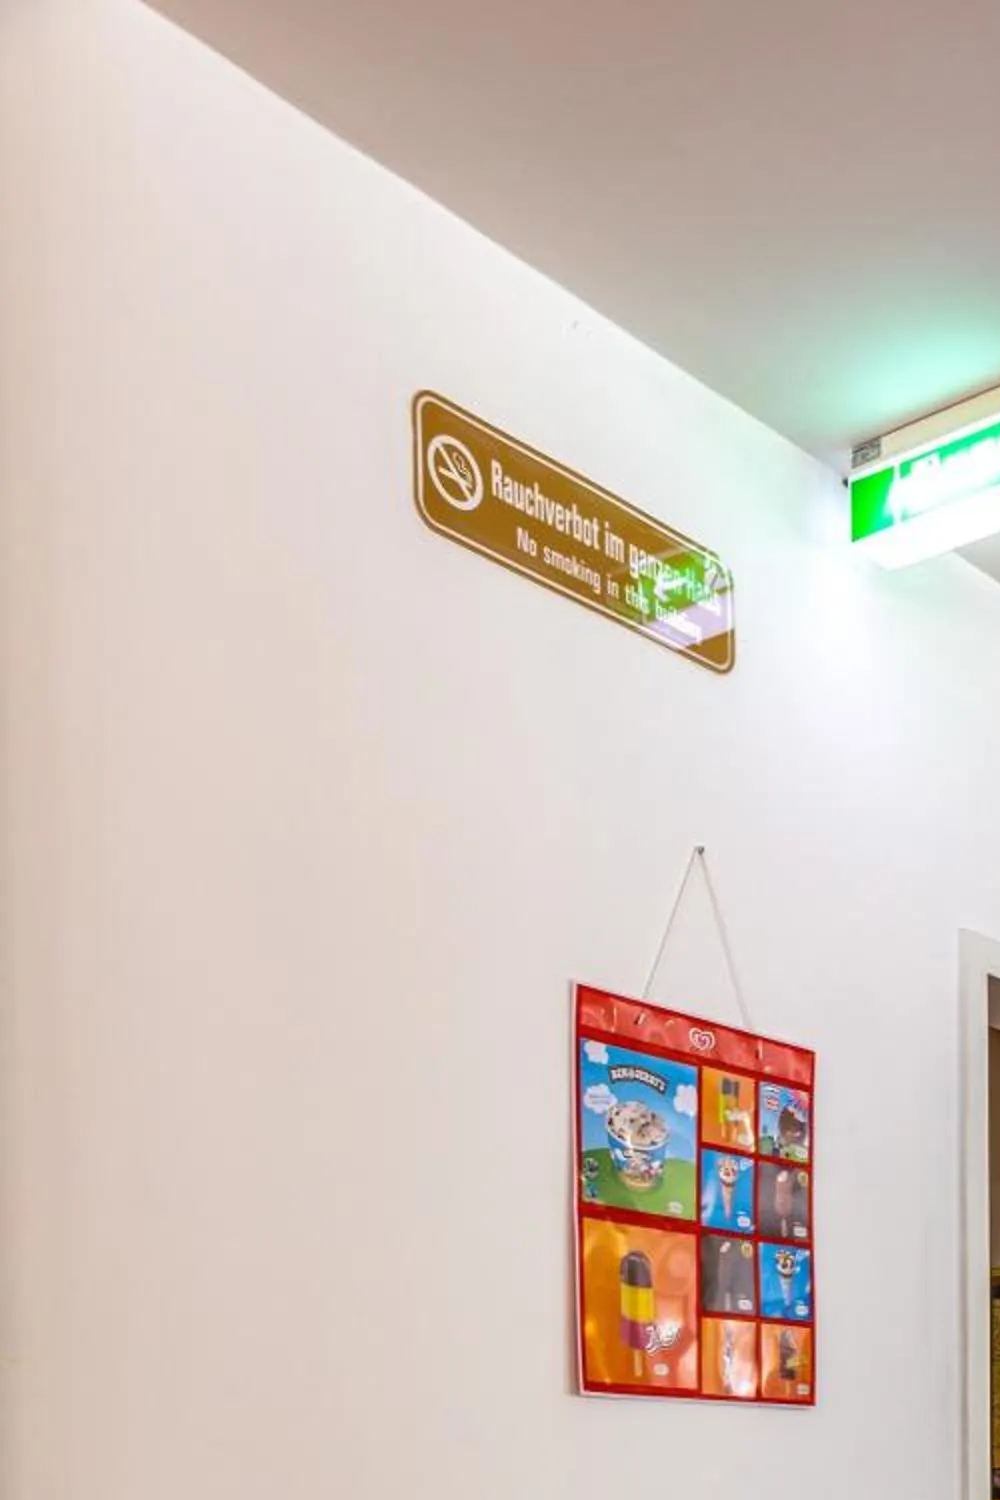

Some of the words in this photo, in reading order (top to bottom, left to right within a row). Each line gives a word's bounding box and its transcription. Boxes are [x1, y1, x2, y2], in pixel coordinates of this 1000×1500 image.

[491, 458, 600, 551] Rauchverbot
[604, 521, 625, 563] im
[517, 526, 537, 557] No
[543, 545, 601, 595] smoking
[606, 573, 619, 600] in
